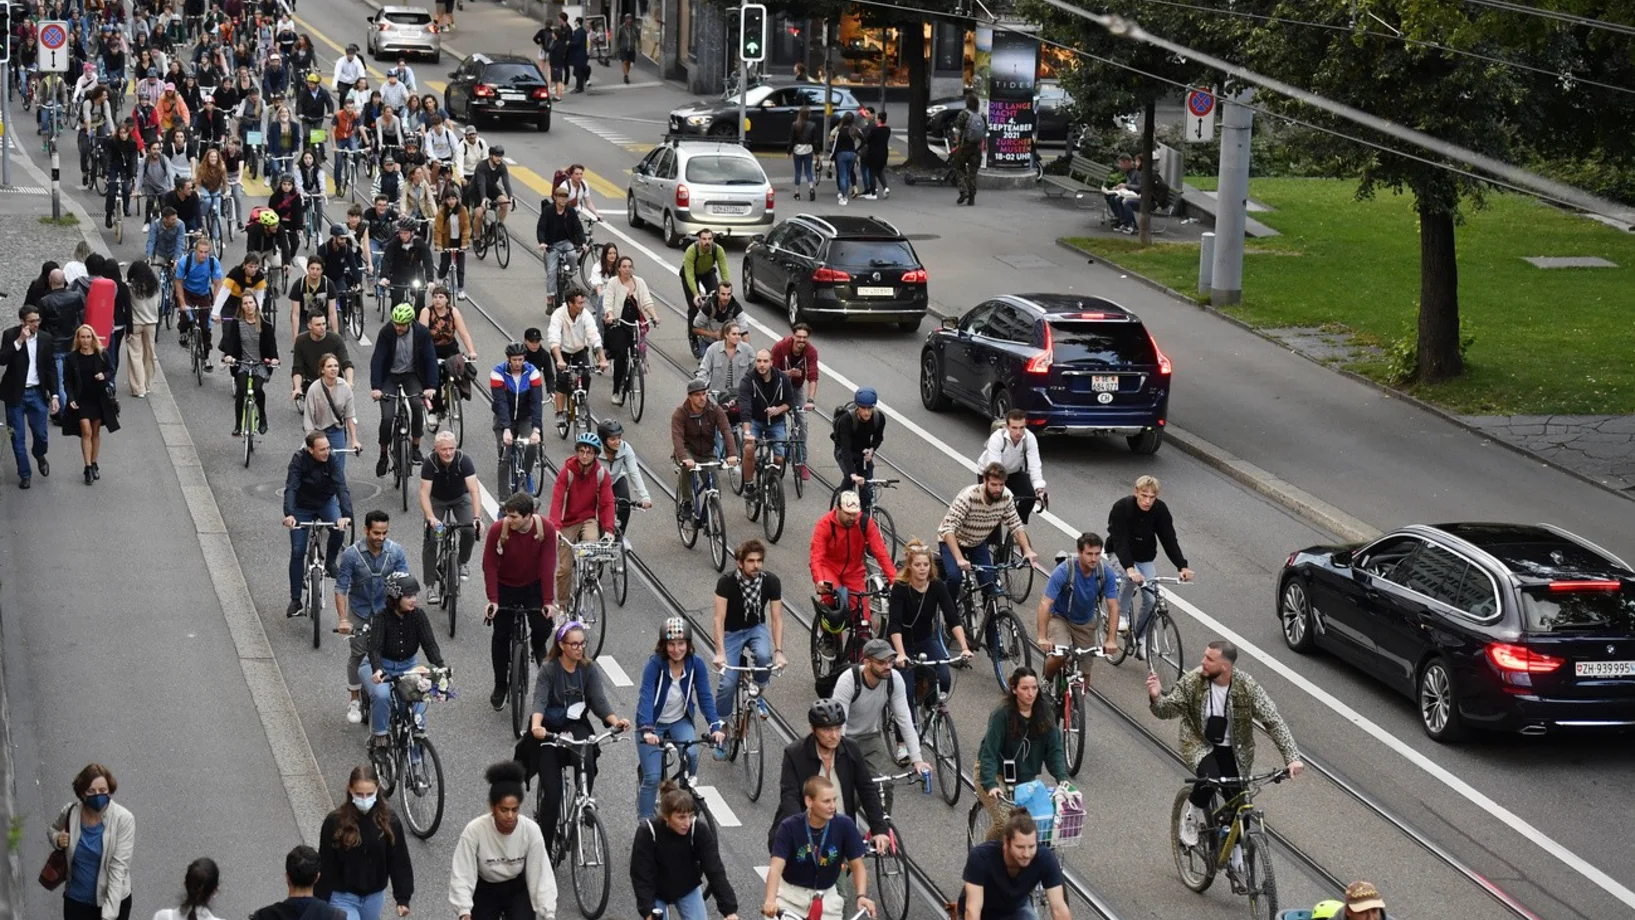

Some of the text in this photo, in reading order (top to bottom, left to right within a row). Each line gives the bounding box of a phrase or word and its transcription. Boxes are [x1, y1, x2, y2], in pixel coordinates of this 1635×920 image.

[995, 80, 1031, 89] TIDES
[990, 101, 1031, 110] DIE LANGE
[1008, 117, 1016, 125] 4.
[988, 123, 1032, 131] SEPTEMBER
[1100, 394, 1110, 402] CH
